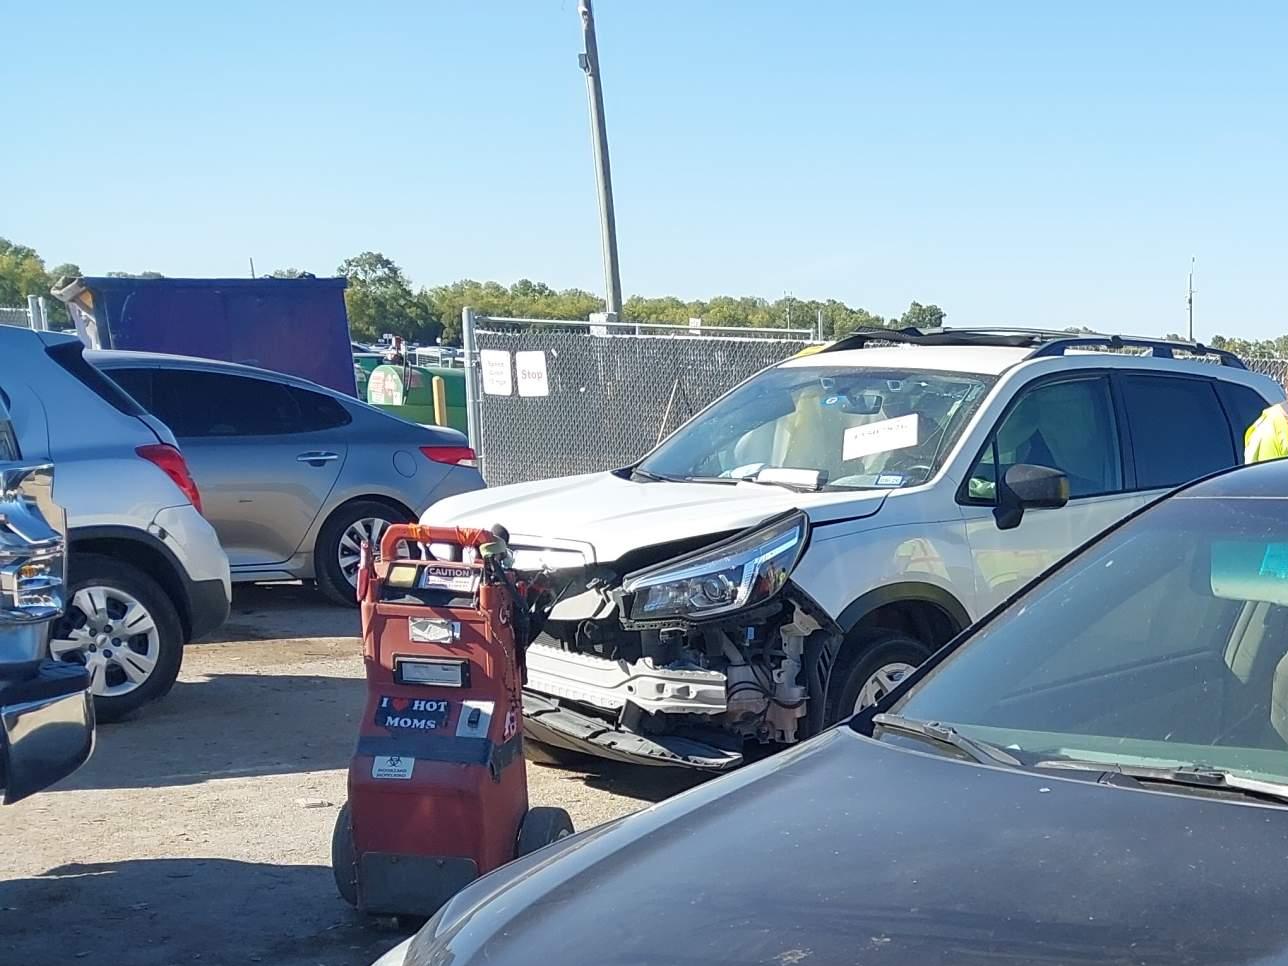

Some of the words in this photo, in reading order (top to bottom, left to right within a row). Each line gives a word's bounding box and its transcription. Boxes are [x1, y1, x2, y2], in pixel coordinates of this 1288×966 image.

[521, 369, 543, 380] Stop
[429, 567, 470, 577] CAUTION
[381, 698, 389, 707] I
[412, 701, 448, 712] HOT
[385, 716, 436, 729] MOMS
